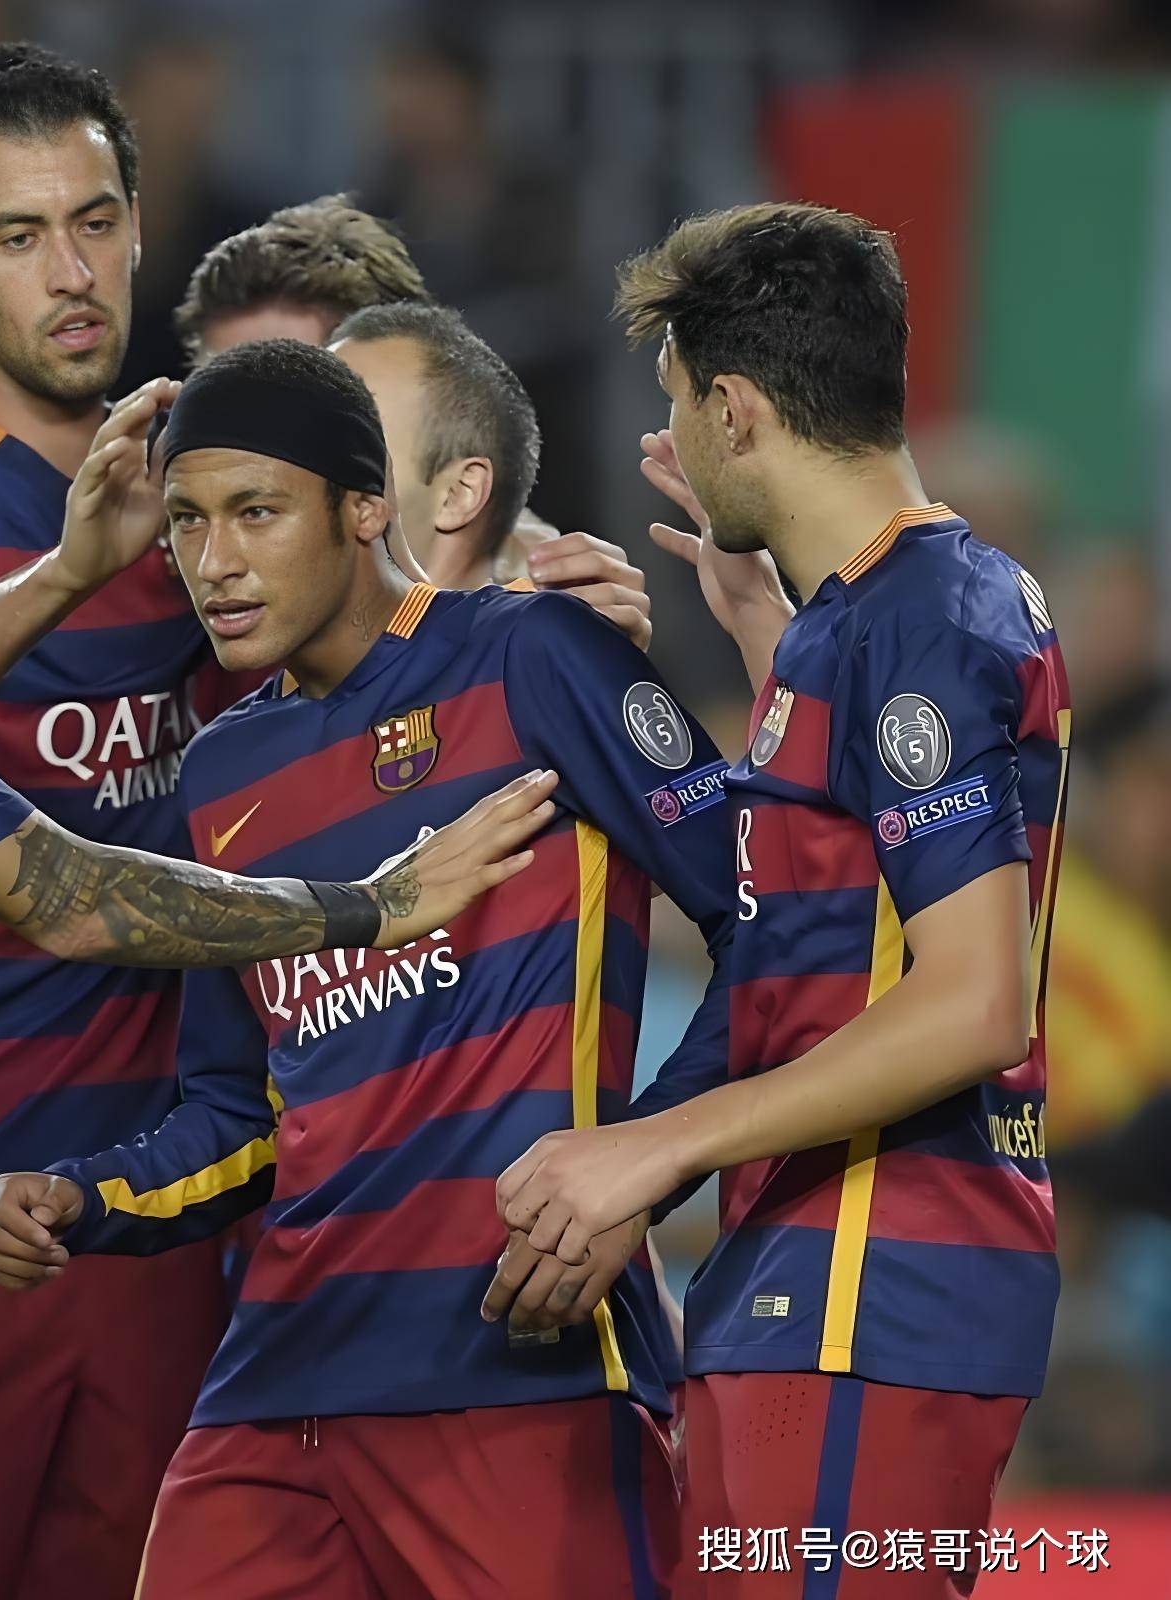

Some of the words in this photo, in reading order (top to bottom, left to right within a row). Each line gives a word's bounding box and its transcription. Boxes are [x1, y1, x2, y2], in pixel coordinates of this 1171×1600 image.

[657, 723, 672, 746] 5
[908, 739, 925, 763] 5
[907, 785, 989, 829] RESPECT
[298, 946, 461, 1047] AIRWAYS
